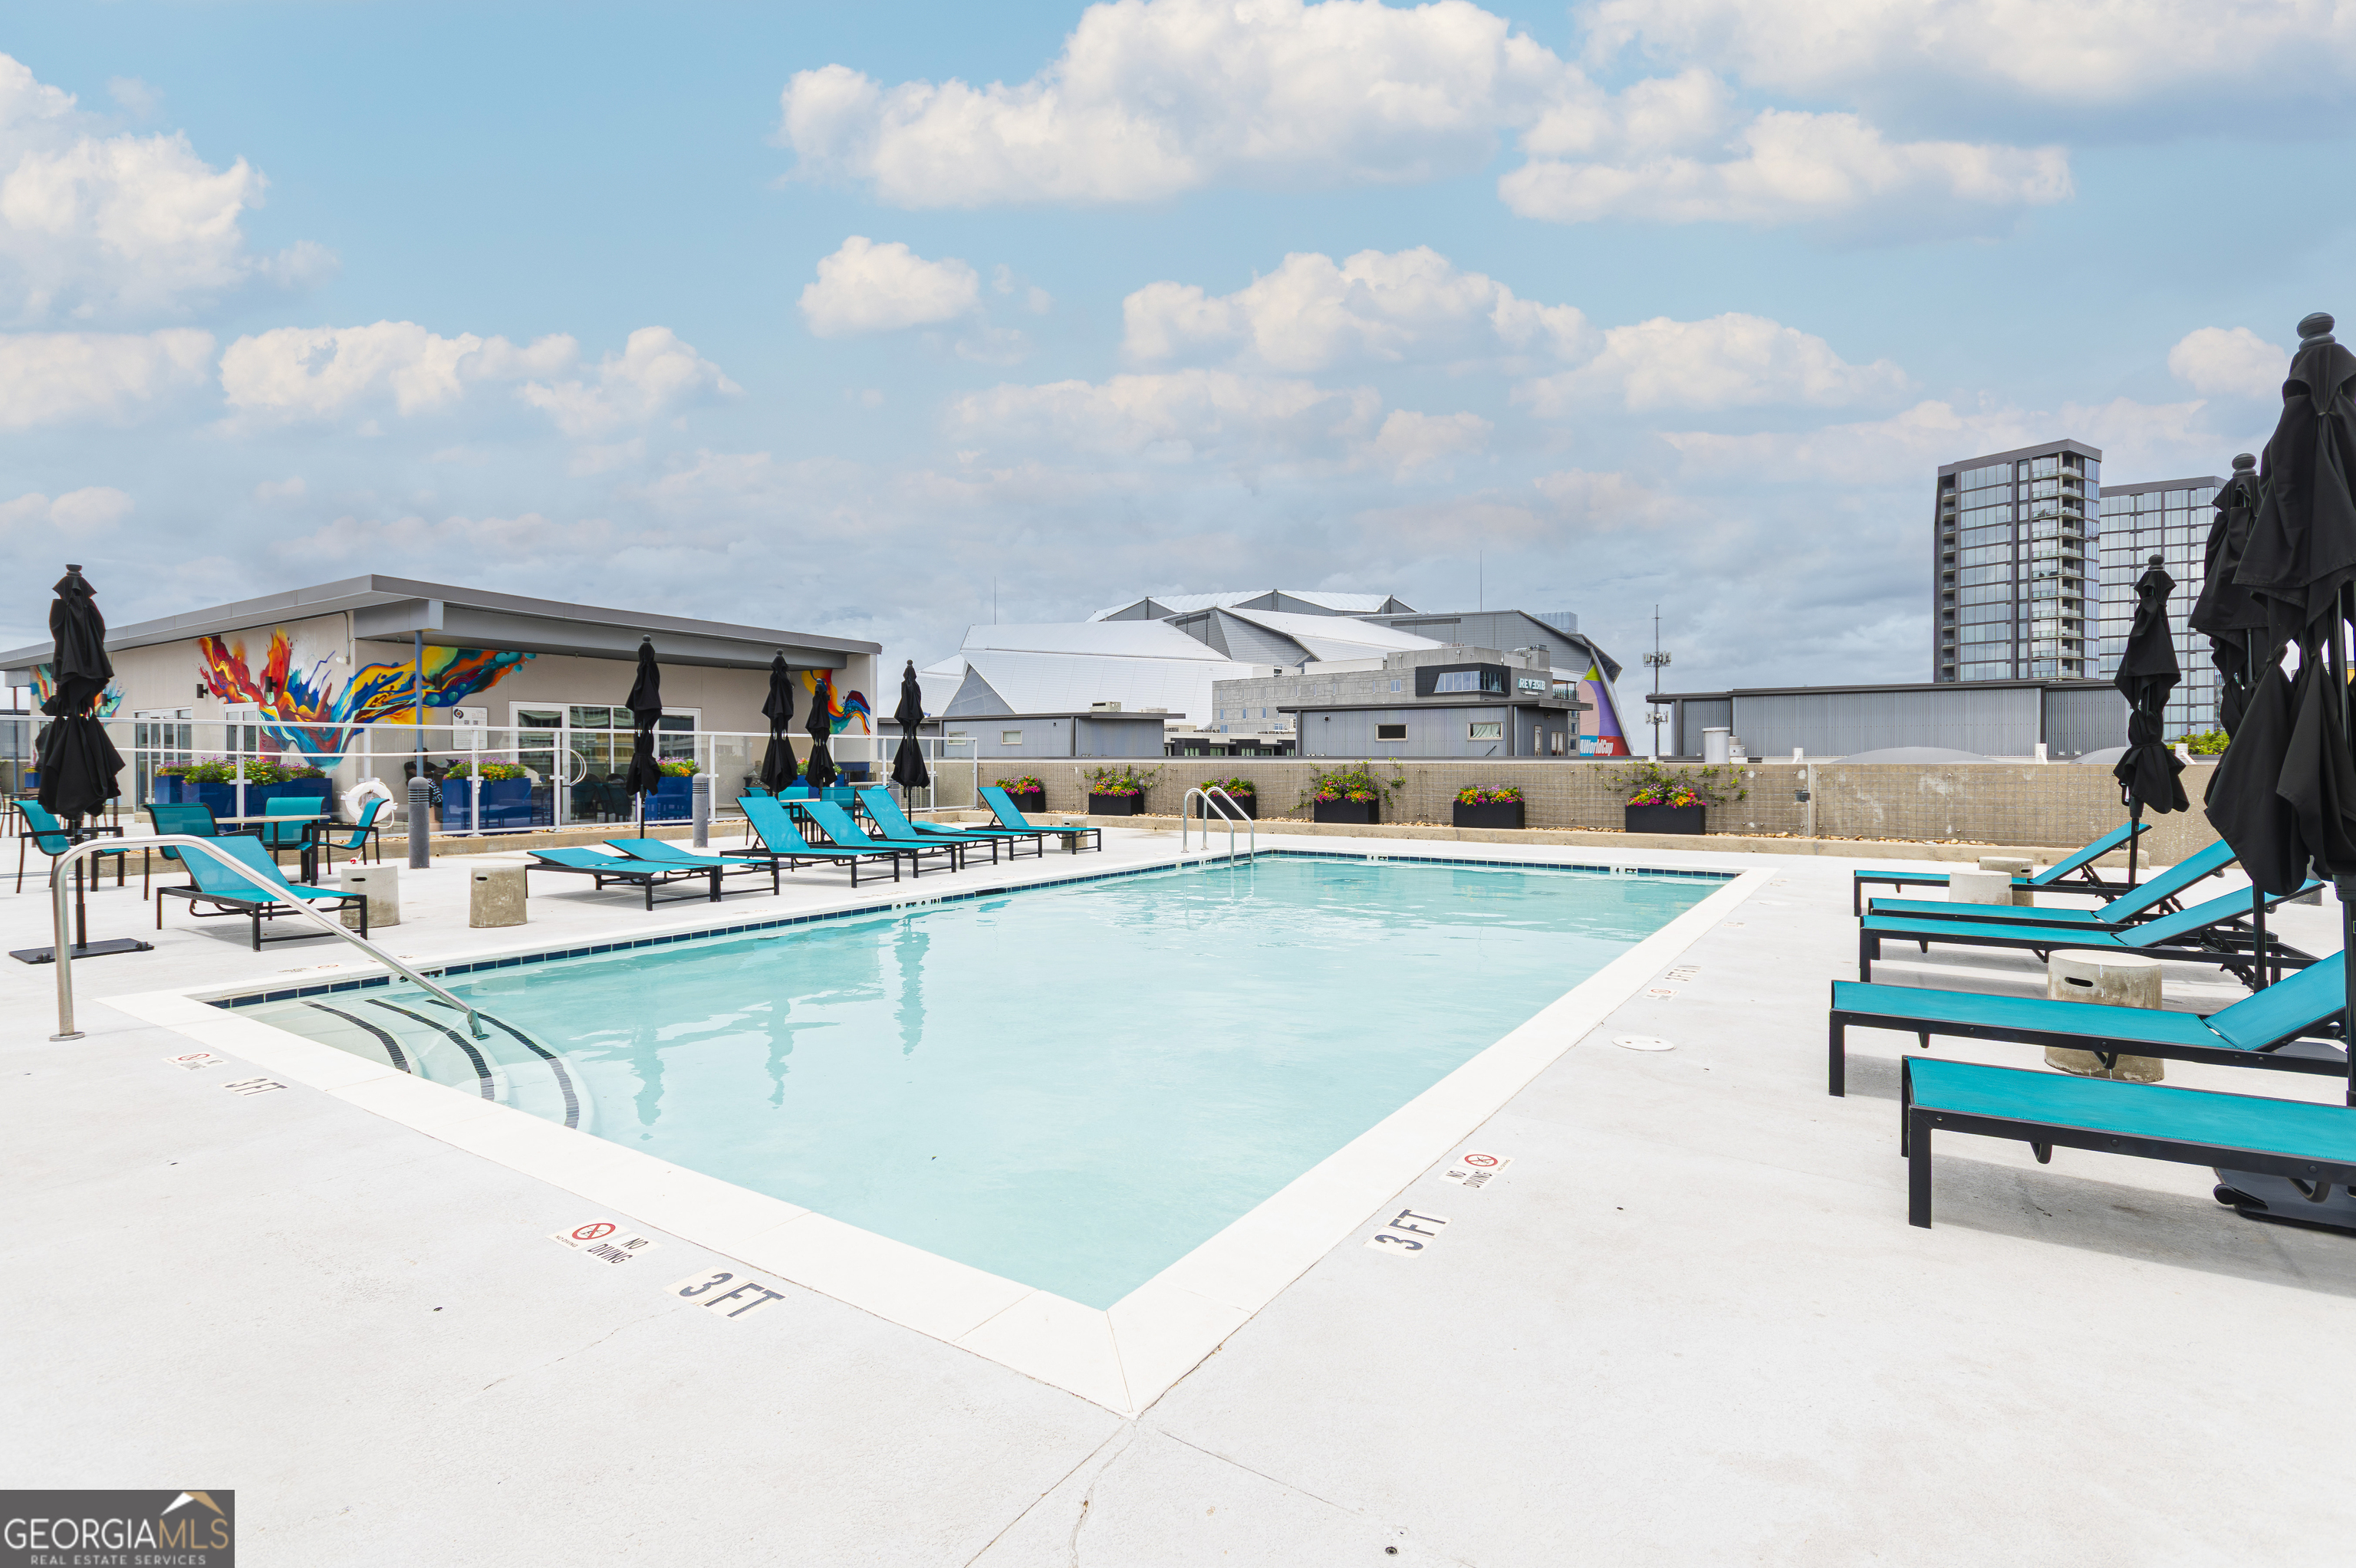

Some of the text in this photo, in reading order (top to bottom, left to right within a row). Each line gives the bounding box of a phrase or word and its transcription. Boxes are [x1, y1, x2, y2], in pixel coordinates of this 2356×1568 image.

[621, 1238, 649, 1250] NO
[1374, 1209, 1446, 1251] 3 FT
[587, 1244, 633, 1264] DIVING
[679, 1273, 785, 1317] 3 FT
